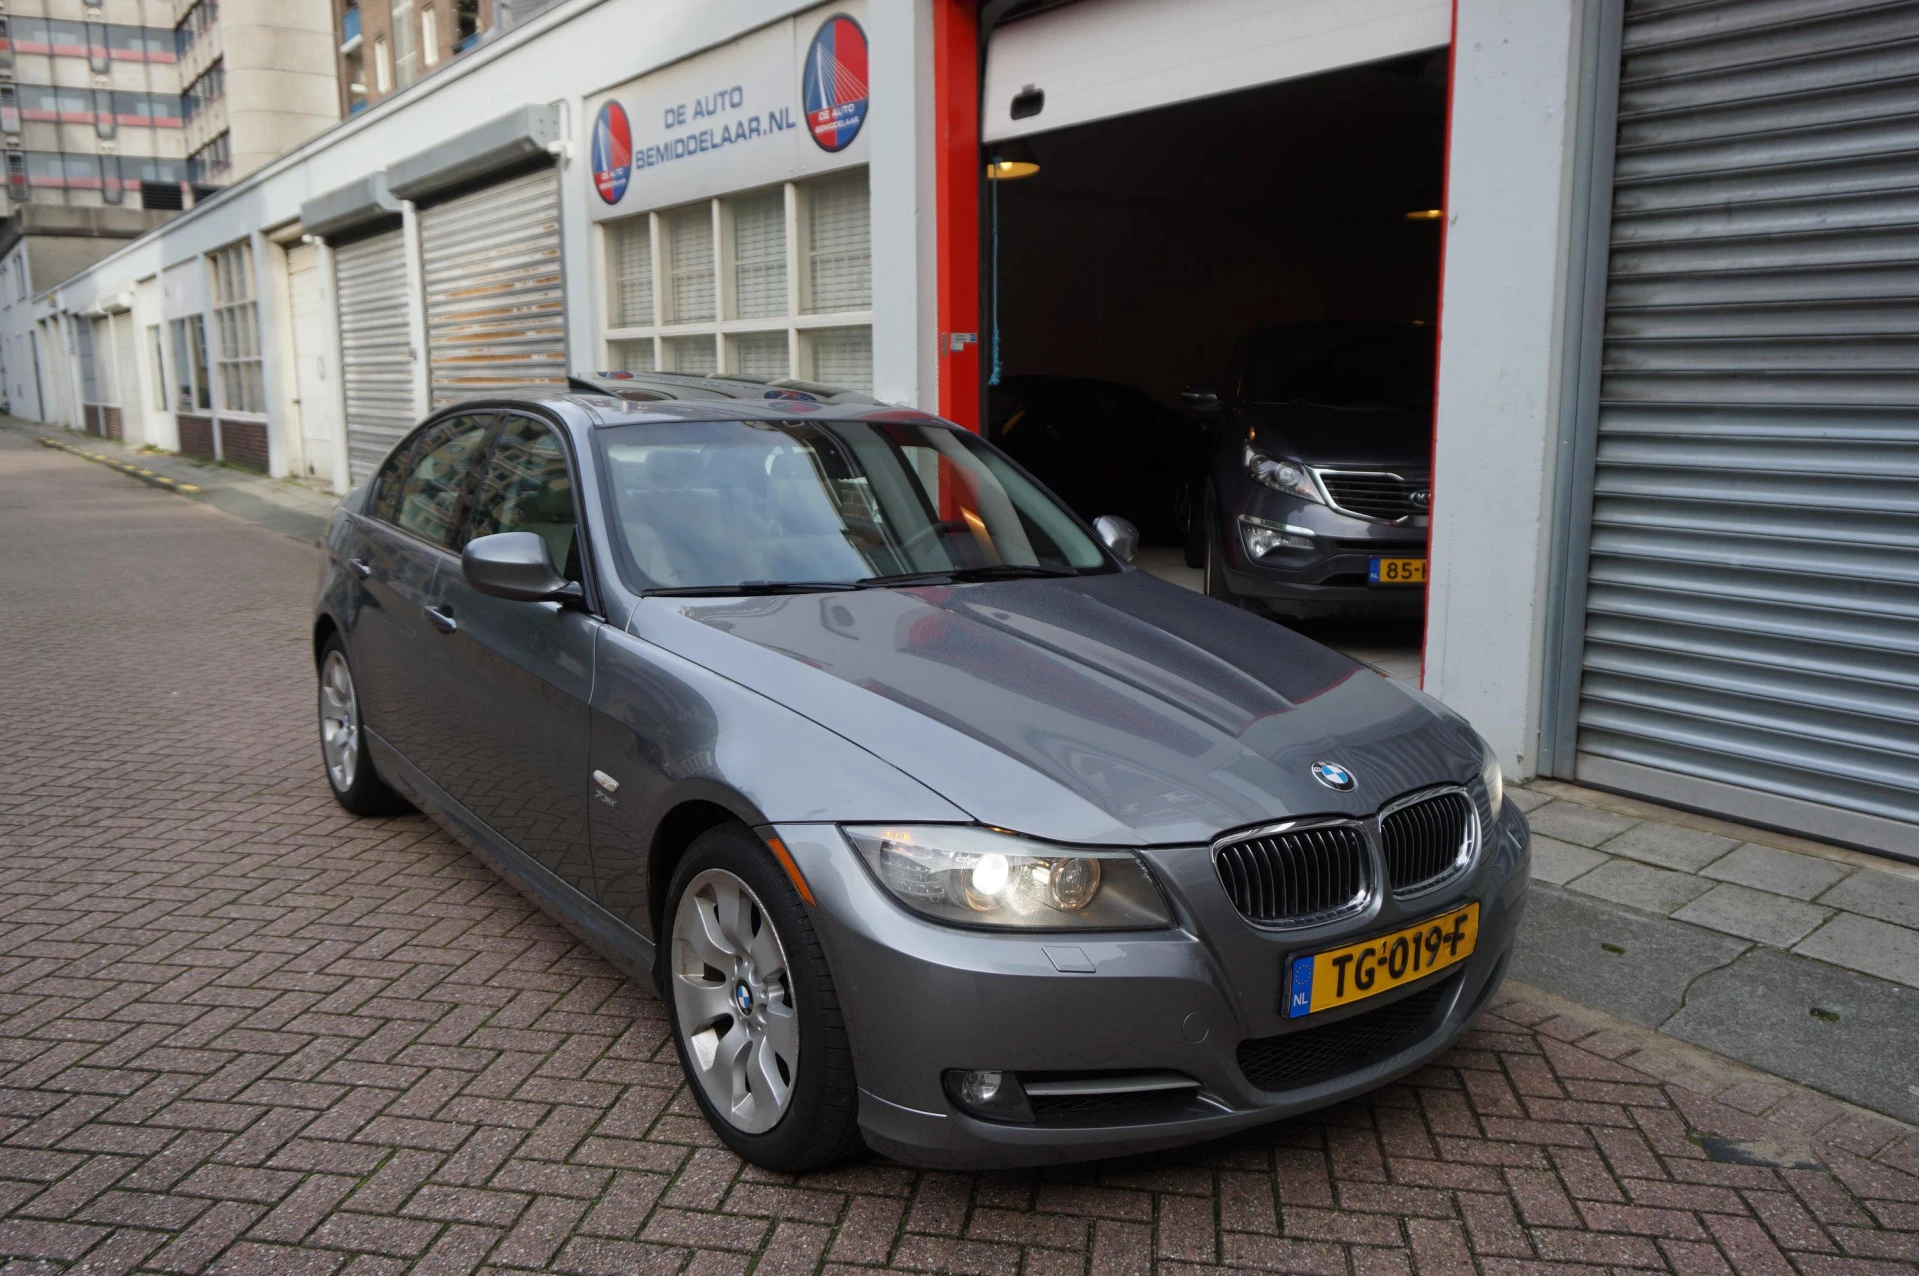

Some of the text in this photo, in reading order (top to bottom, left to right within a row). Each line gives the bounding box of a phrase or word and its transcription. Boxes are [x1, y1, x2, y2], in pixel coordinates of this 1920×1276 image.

[664, 85, 744, 129] DE AUTO
[818, 103, 856, 121] DE AUTO
[635, 106, 797, 170] BEMIDDELAAR.NL
[1332, 913, 1469, 998] TG-019-F
[1293, 991, 1308, 1007] NL
